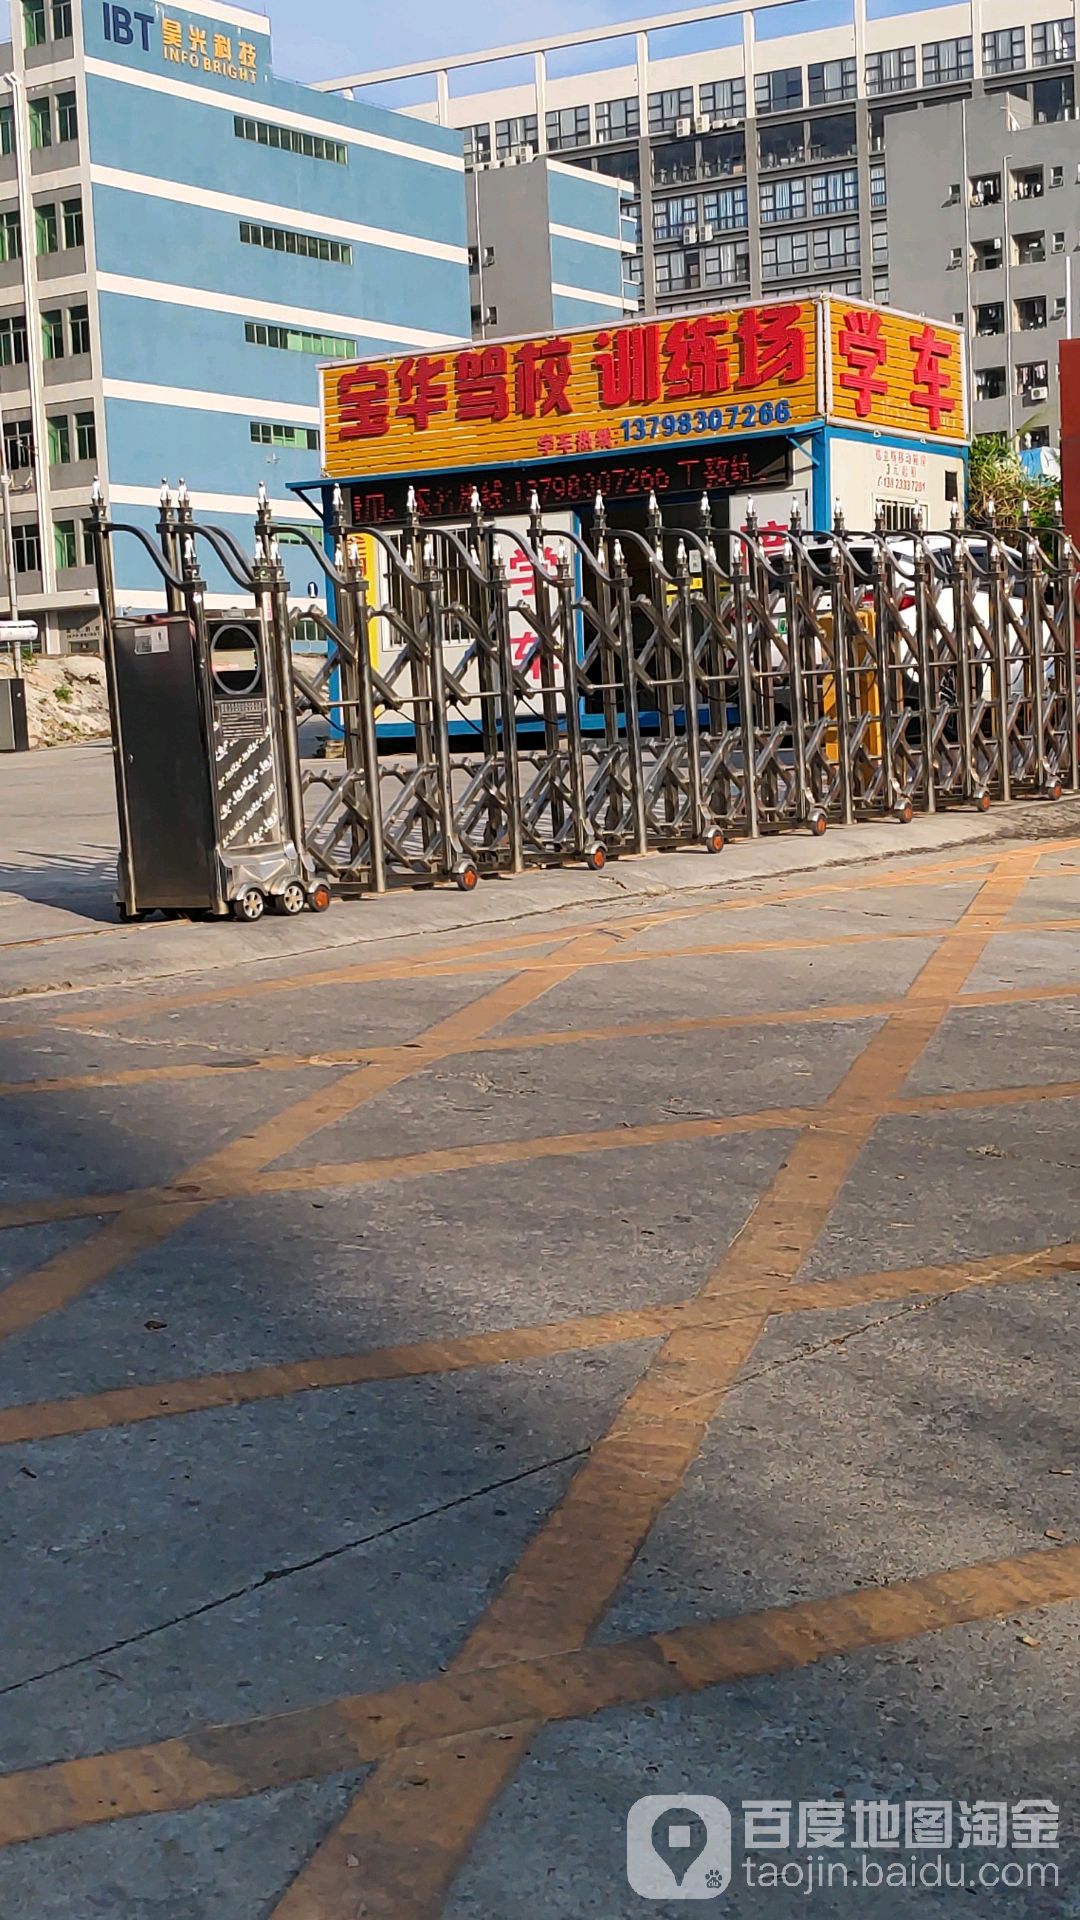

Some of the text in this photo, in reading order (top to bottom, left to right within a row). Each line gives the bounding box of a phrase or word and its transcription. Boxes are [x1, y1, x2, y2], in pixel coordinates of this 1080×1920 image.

[102, 2, 155, 52] IBT
[162, 17, 257, 69] 昊光科技
[837, 310, 956, 431] 学车
[620, 400, 791, 442] 13798307266
